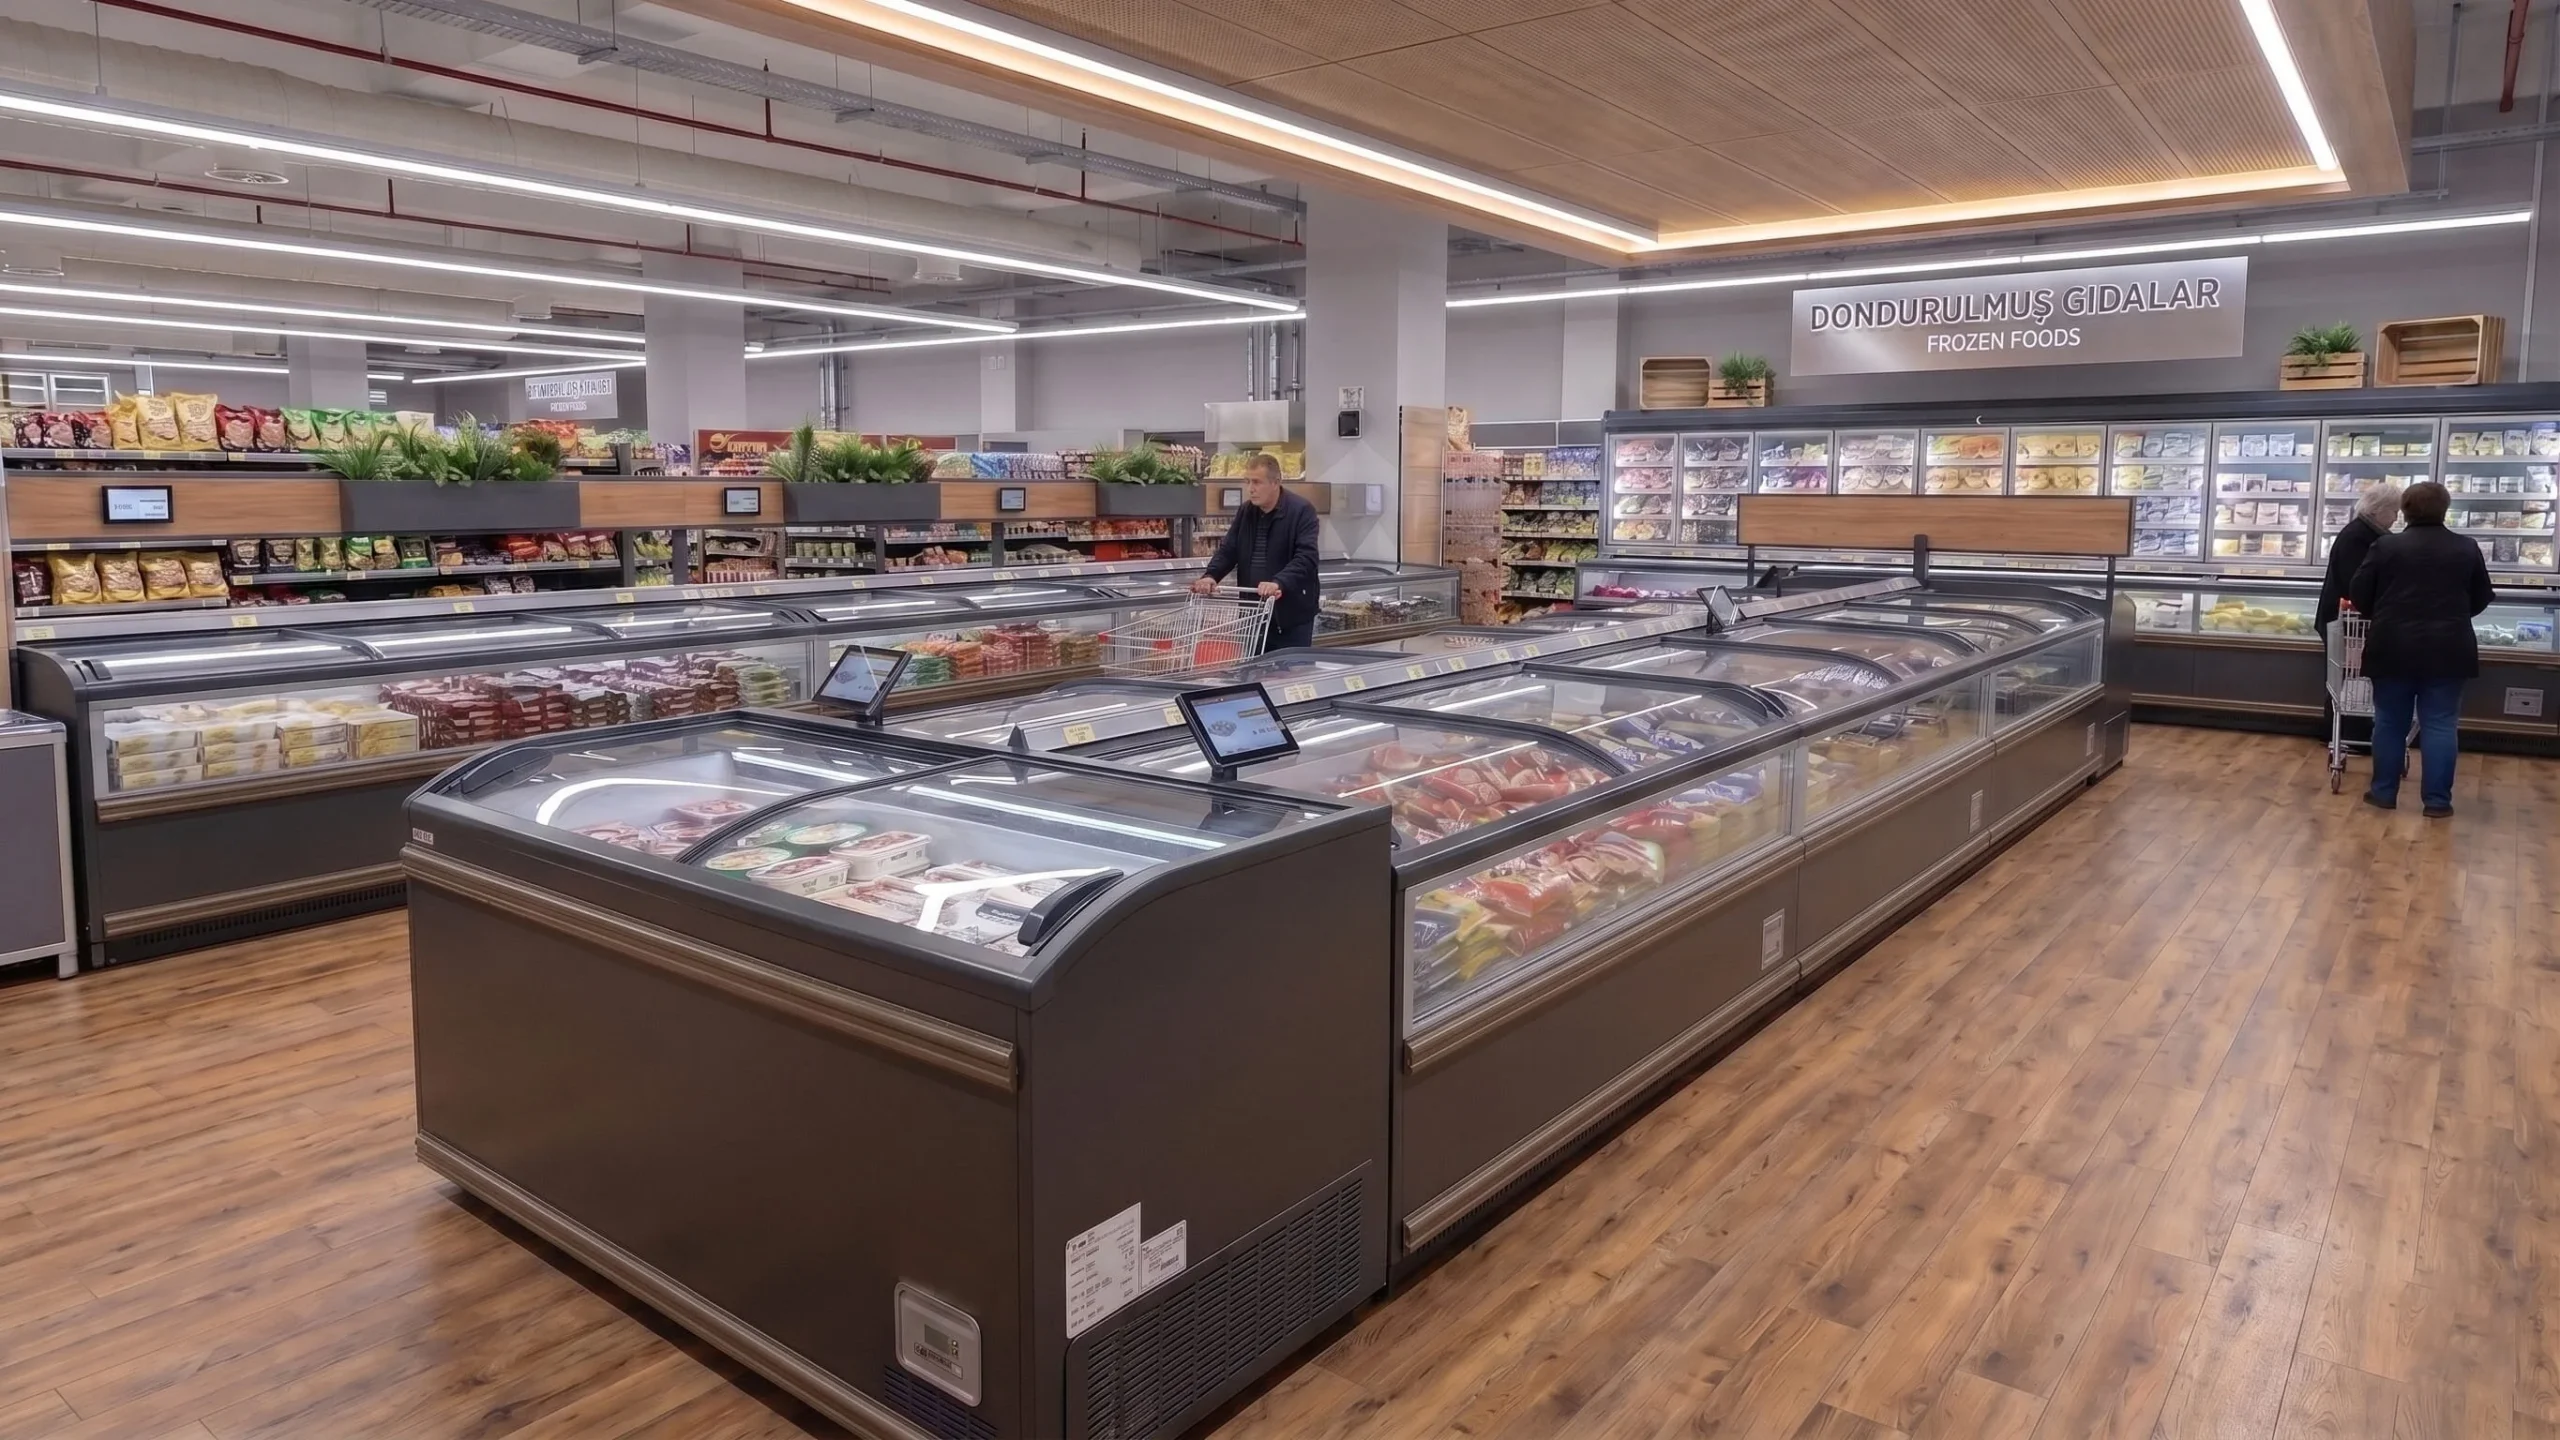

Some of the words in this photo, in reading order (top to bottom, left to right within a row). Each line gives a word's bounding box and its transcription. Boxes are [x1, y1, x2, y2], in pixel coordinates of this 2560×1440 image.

[1811, 289, 2053, 332] DONDURULMUŞ
[2062, 278, 2220, 316] GIDALAR
[1927, 332, 2004, 353] FROZEN
[2010, 328, 2081, 349] FOODS
